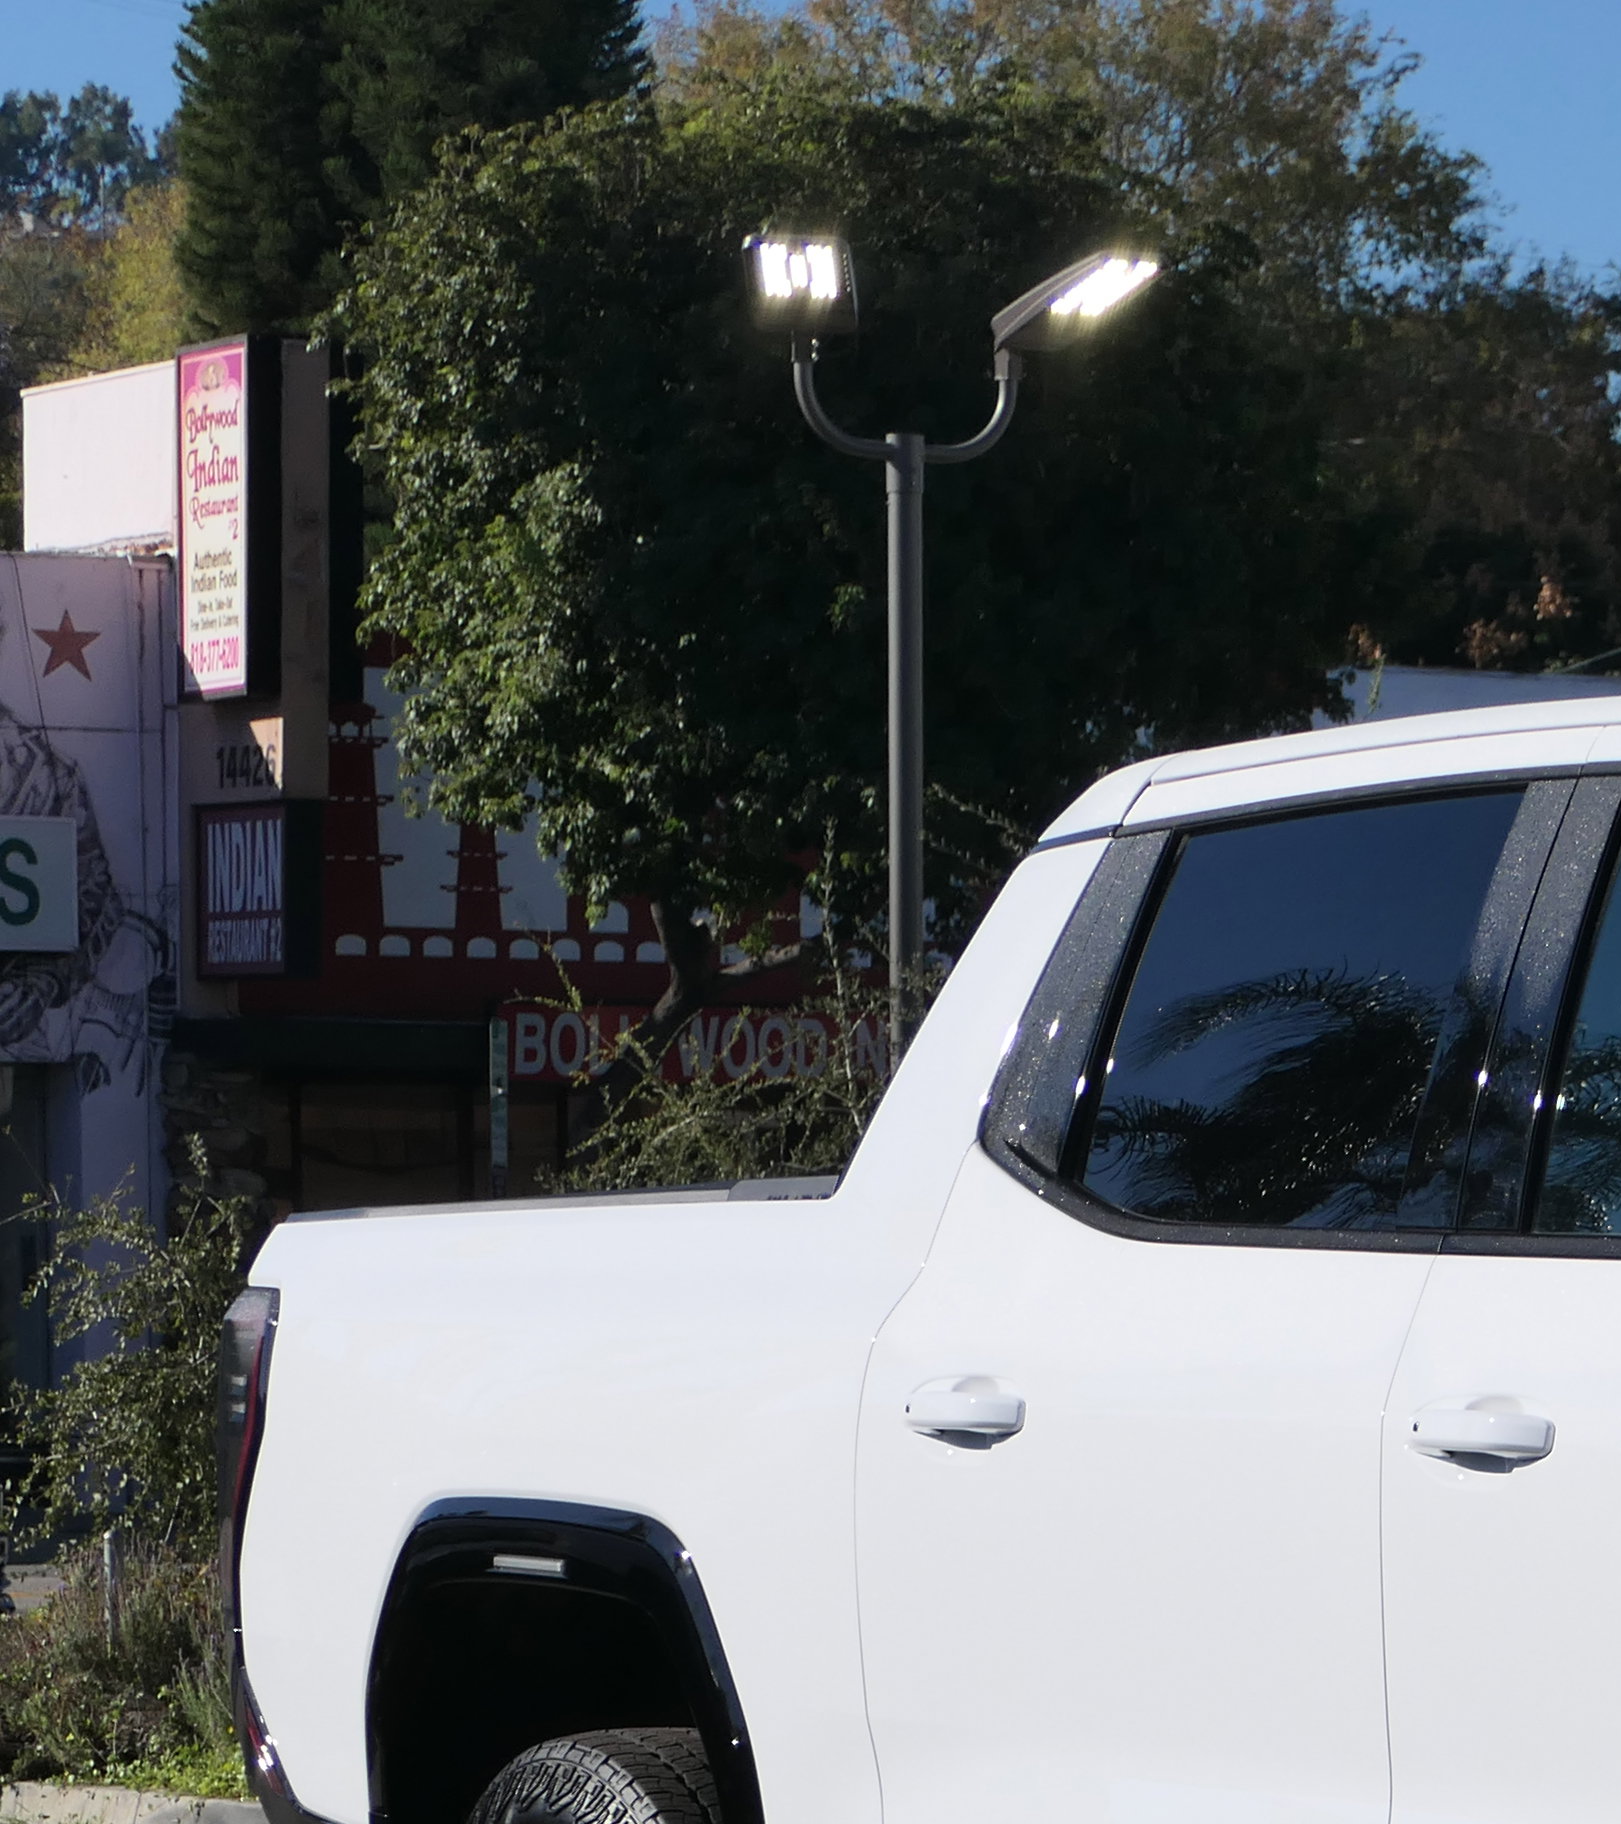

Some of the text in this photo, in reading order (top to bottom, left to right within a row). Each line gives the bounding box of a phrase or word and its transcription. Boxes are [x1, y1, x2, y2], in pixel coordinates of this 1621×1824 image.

[186, 445, 239, 492] Indian
[189, 496, 239, 529] Restaurant
[190, 569, 238, 594] Indian Food
[193, 550, 233, 571] Authentic
[216, 743, 277, 790] 14426
[0, 837, 41, 927] S
[208, 819, 283, 913] INDIAN
